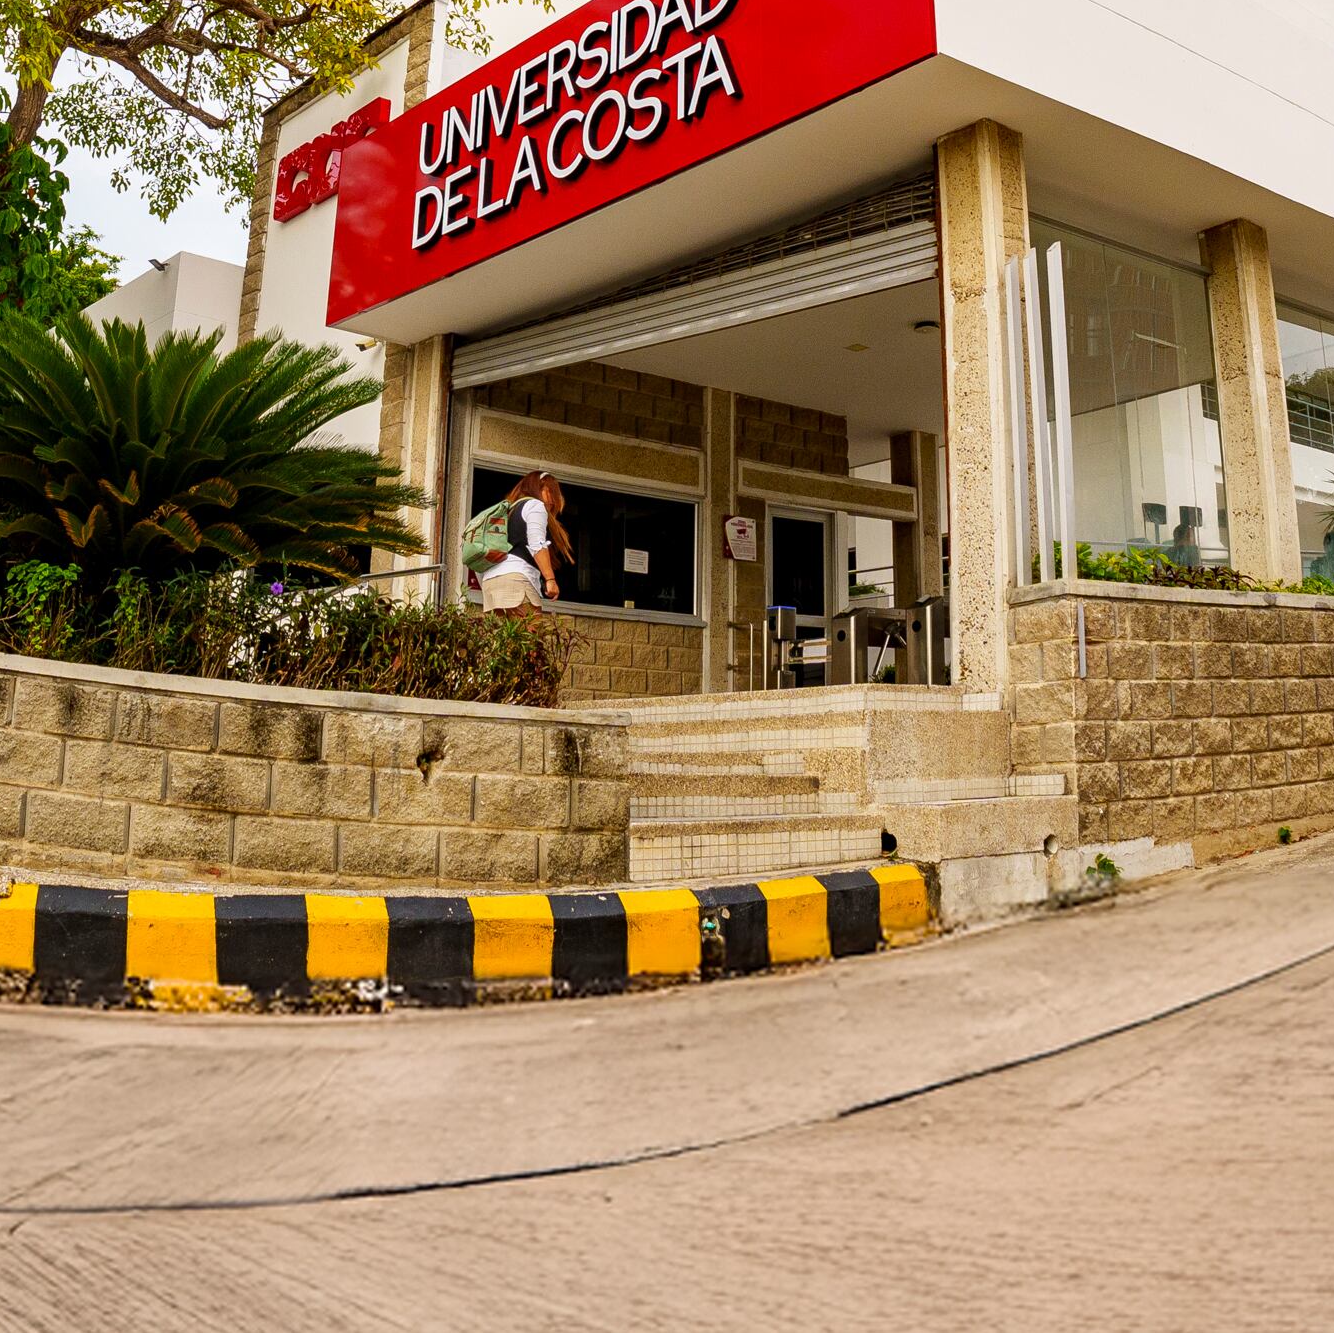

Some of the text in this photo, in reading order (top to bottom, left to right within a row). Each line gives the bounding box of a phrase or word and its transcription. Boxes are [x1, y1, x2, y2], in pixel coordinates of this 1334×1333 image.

[411, 34, 736, 249] DE LA COSTA
